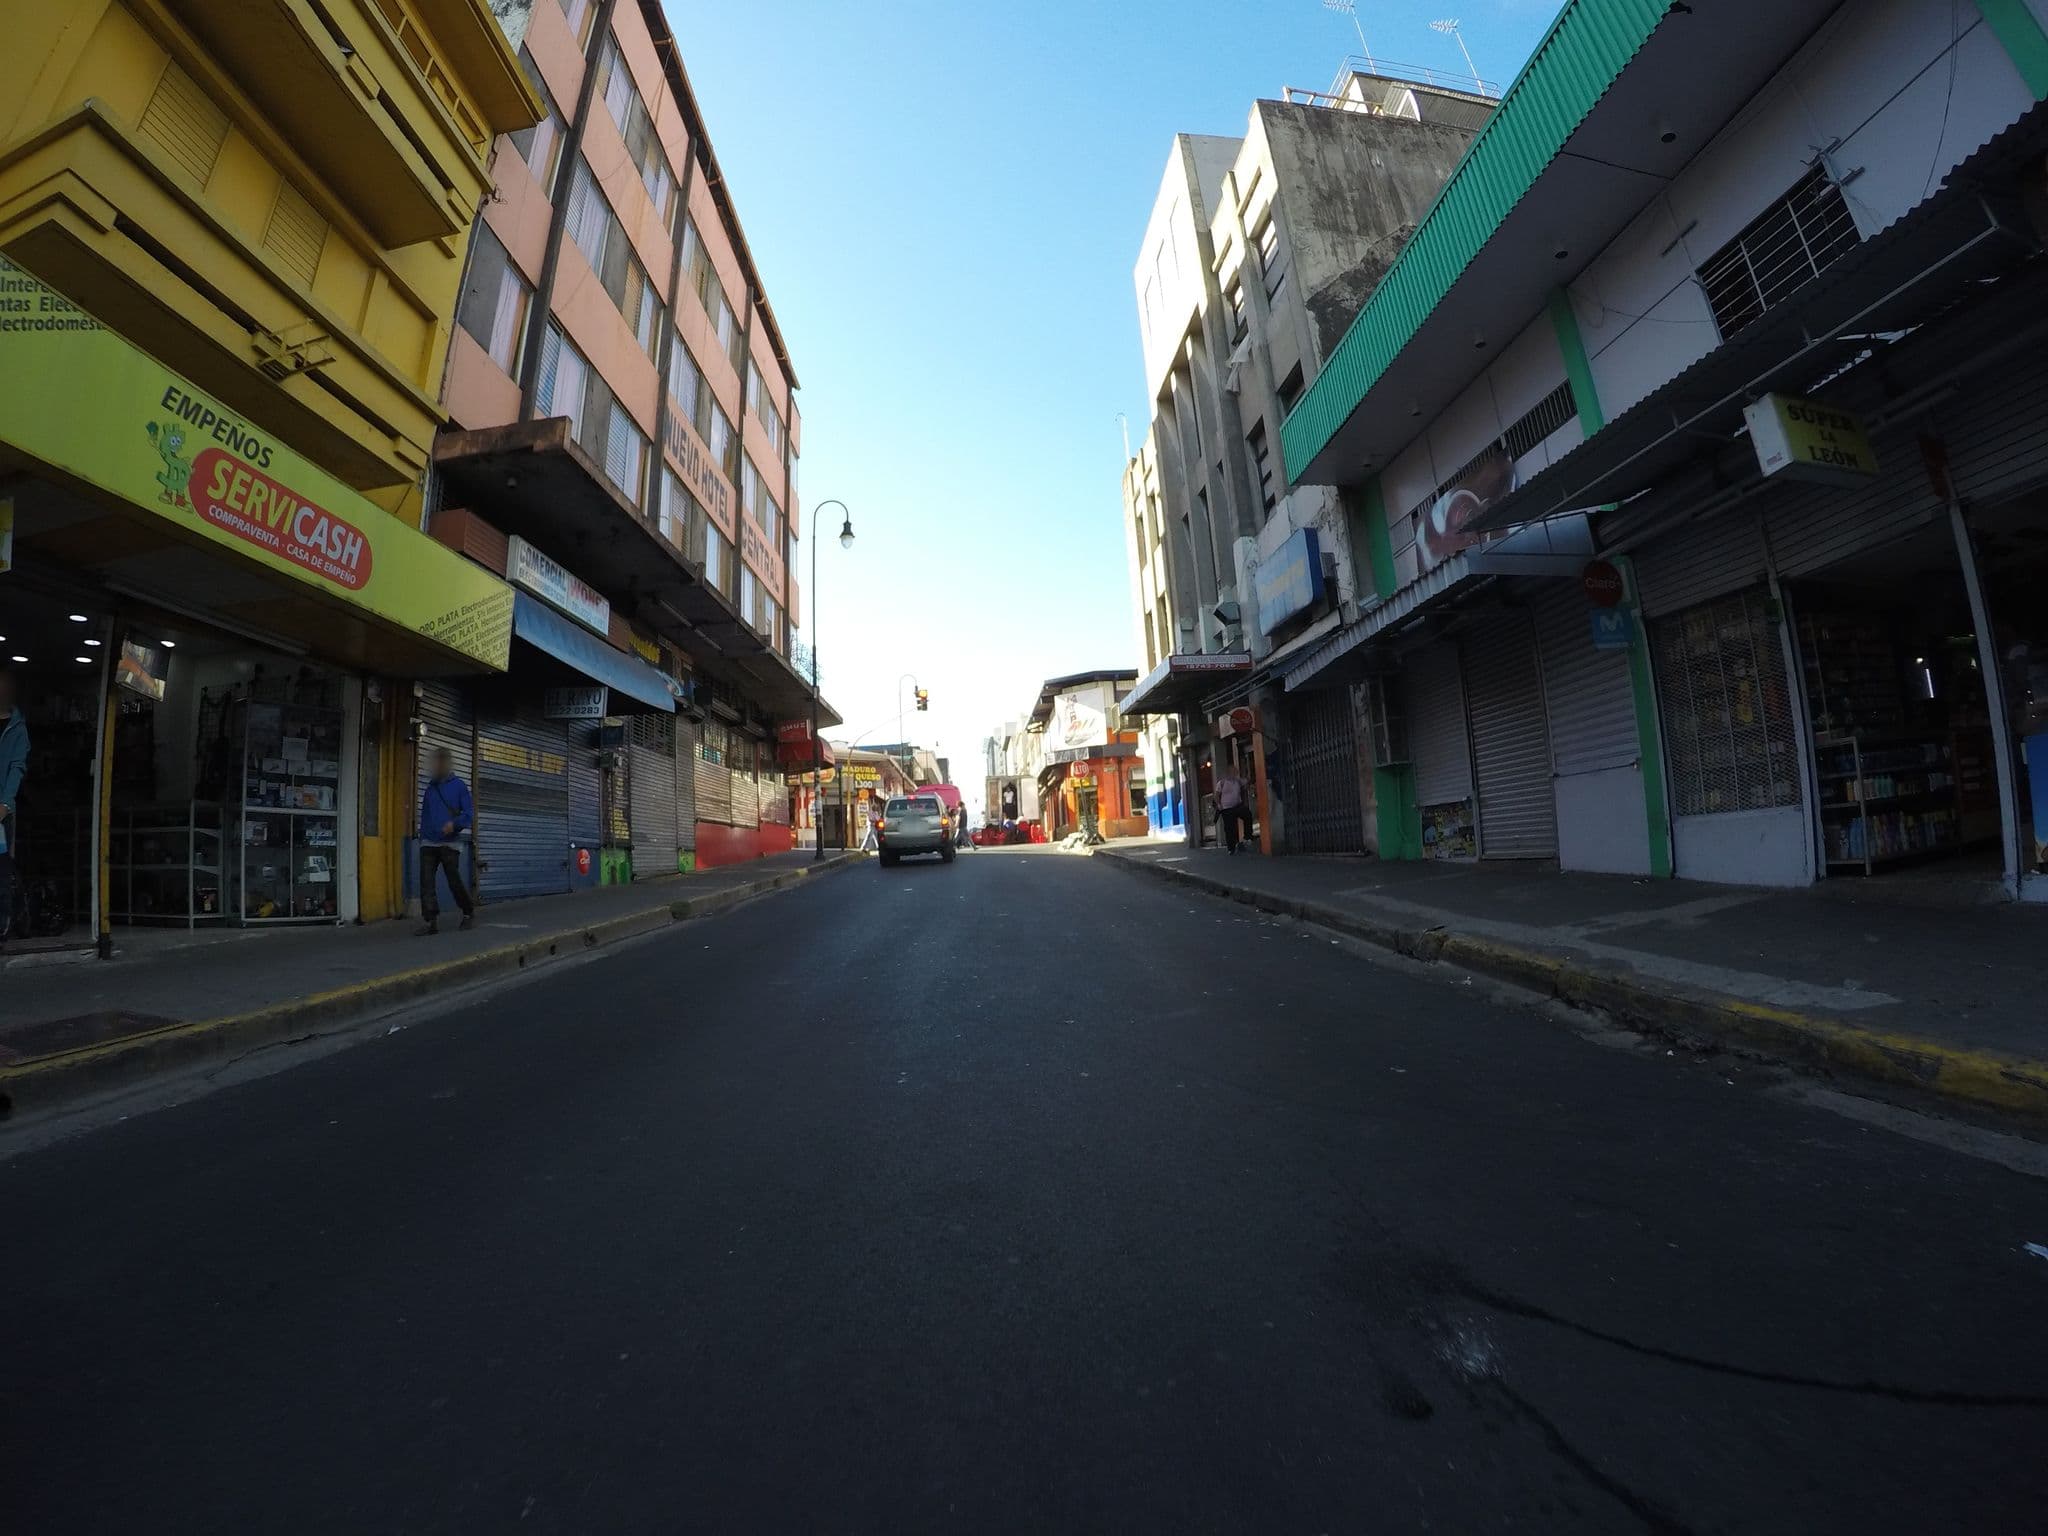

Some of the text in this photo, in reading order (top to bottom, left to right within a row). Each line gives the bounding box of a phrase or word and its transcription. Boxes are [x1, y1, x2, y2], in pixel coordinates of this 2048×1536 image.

[161, 385, 274, 468] EMPEÑOS
[1786, 402, 1856, 432] SUPER
[664, 408, 730, 529] NUEVO HOTEL
[1807, 445, 1858, 469] LEÓN
[206, 459, 363, 570] SERVICASH
[208, 504, 357, 585] COMPRAVENTA CASA DE EMPEÑO
[741, 516, 780, 593] CENTRAL
[520, 543, 567, 593] COMERCIAL
[1584, 576, 1617, 590] Claro
[437, 609, 460, 627] PLATA
[459, 622, 480, 641] PLATA
[1073, 763, 1088, 775] ALTO
